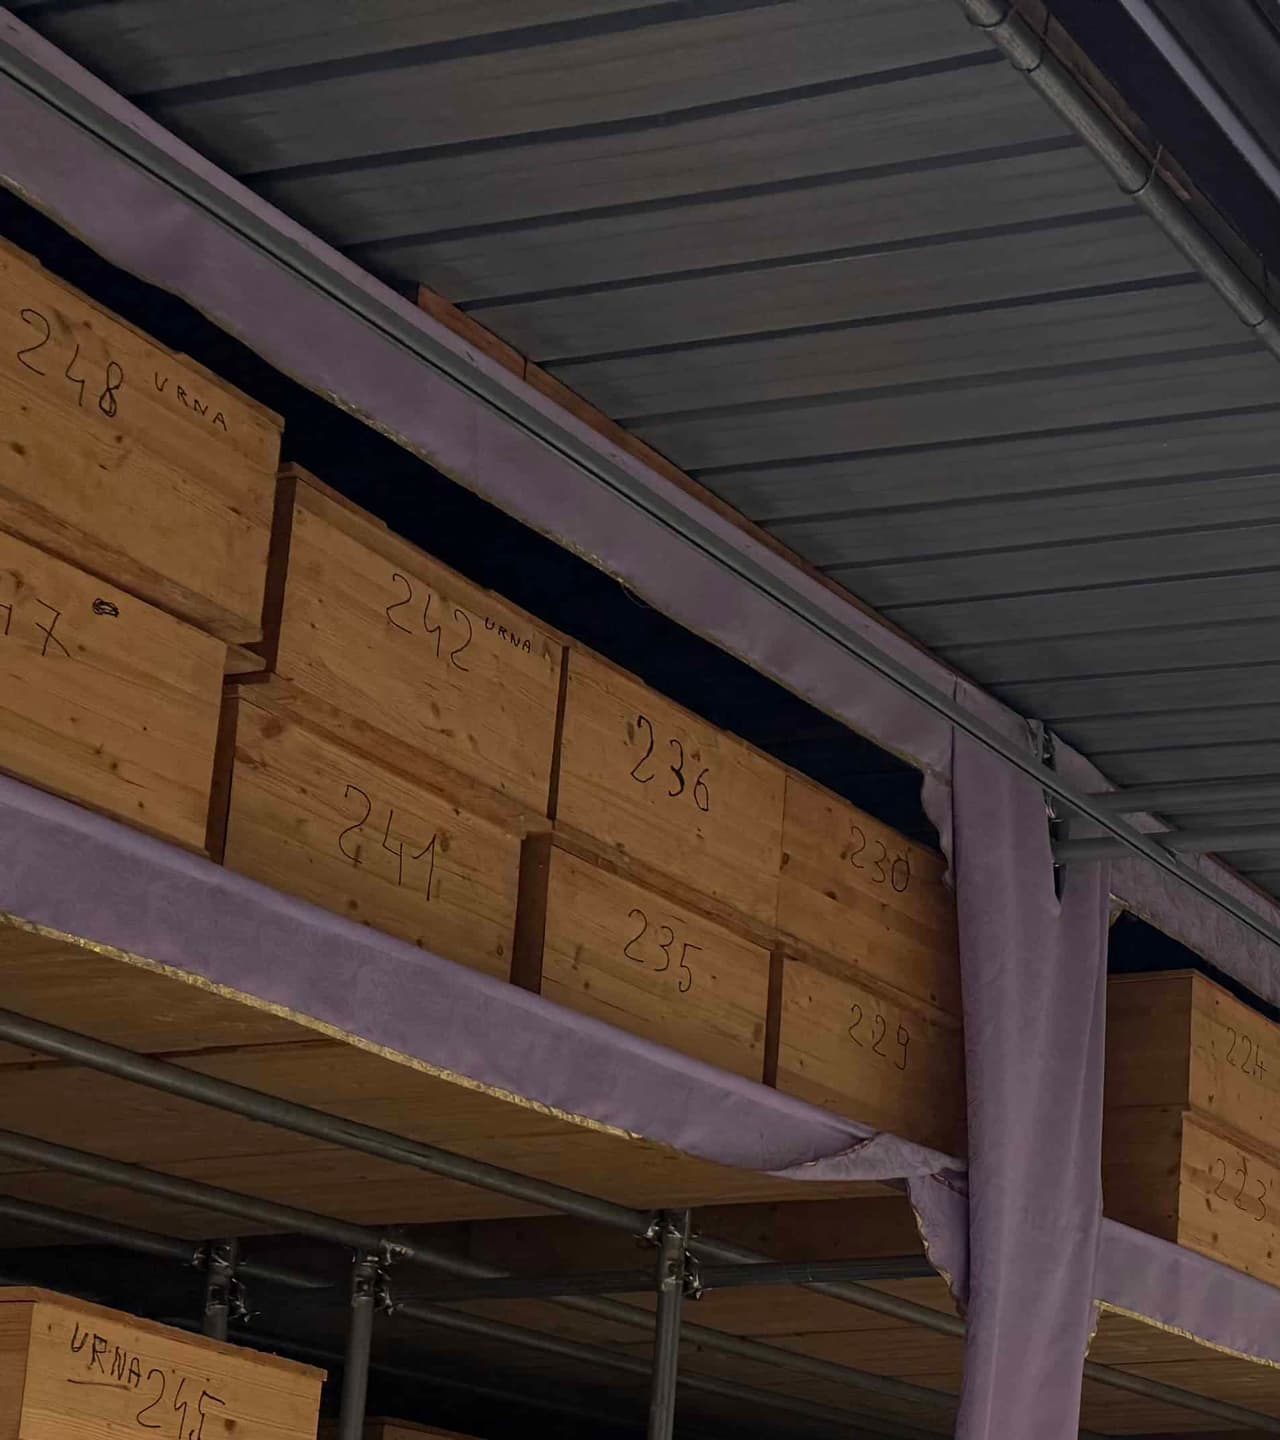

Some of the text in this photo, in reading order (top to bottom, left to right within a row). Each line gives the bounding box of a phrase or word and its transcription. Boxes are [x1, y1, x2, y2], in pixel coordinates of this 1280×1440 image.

[16, 307, 228, 432] 248 URNA
[386, 572, 532, 673] 242 URNA
[630, 714, 710, 812] 236
[338, 783, 438, 902] 241
[850, 825, 911, 893] 230
[623, 908, 703, 993] 235
[847, 1003, 910, 1071] 229
[1224, 1026, 1268, 1081] 224
[1211, 1157, 1267, 1222] 223
[70, 1321, 142, 1389] URNA
